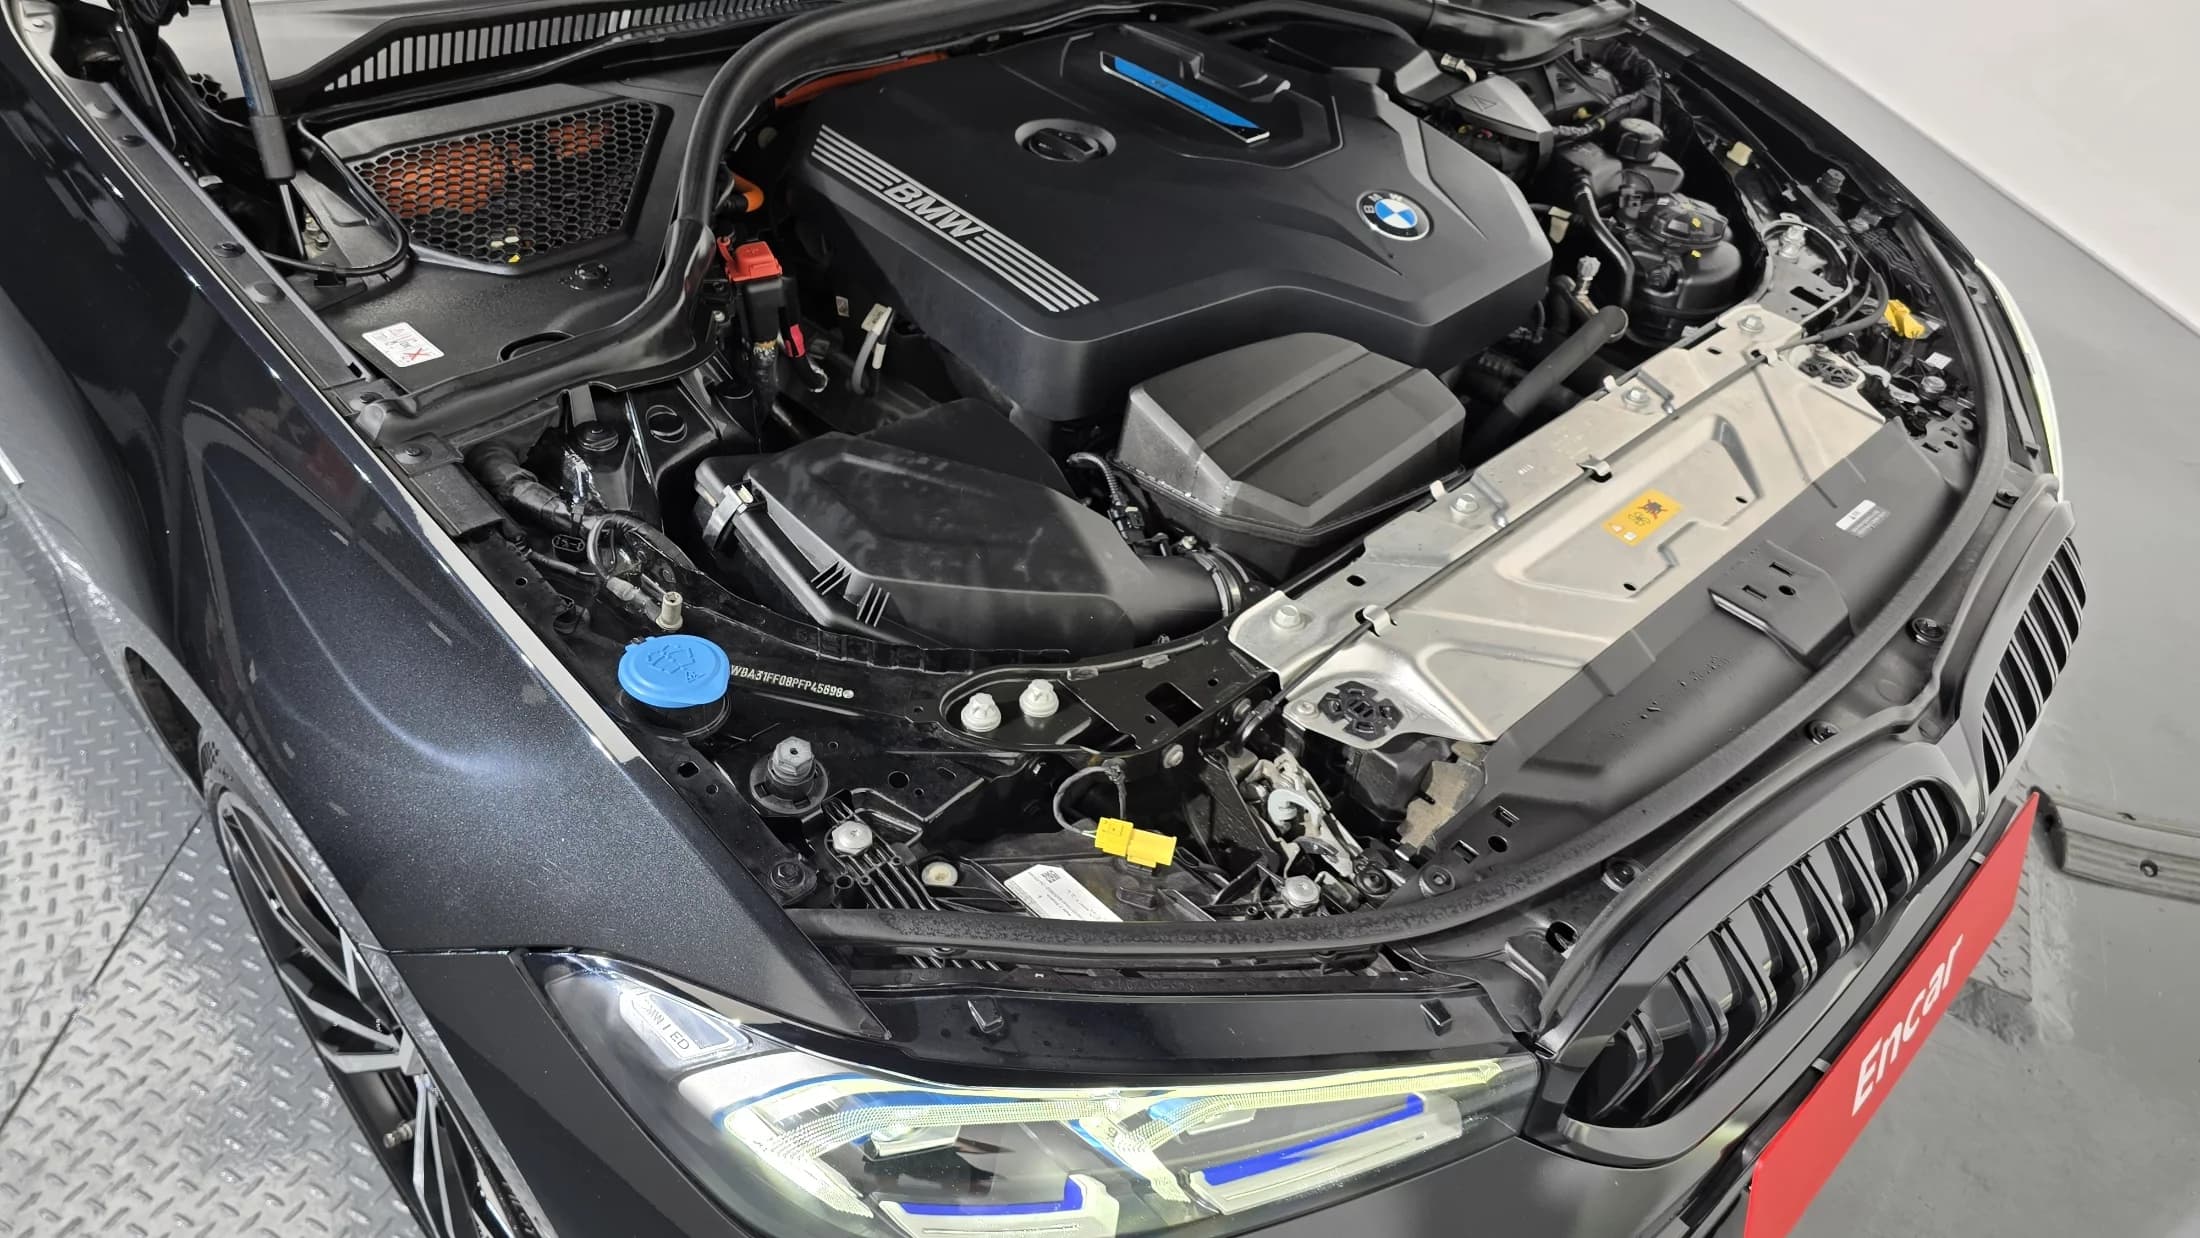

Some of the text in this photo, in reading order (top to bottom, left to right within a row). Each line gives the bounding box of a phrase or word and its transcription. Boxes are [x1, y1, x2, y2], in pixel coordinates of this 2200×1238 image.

[883, 182, 985, 238] BMW
[1363, 192, 1403, 214] BMW
[1852, 933, 1964, 1117] Encar
